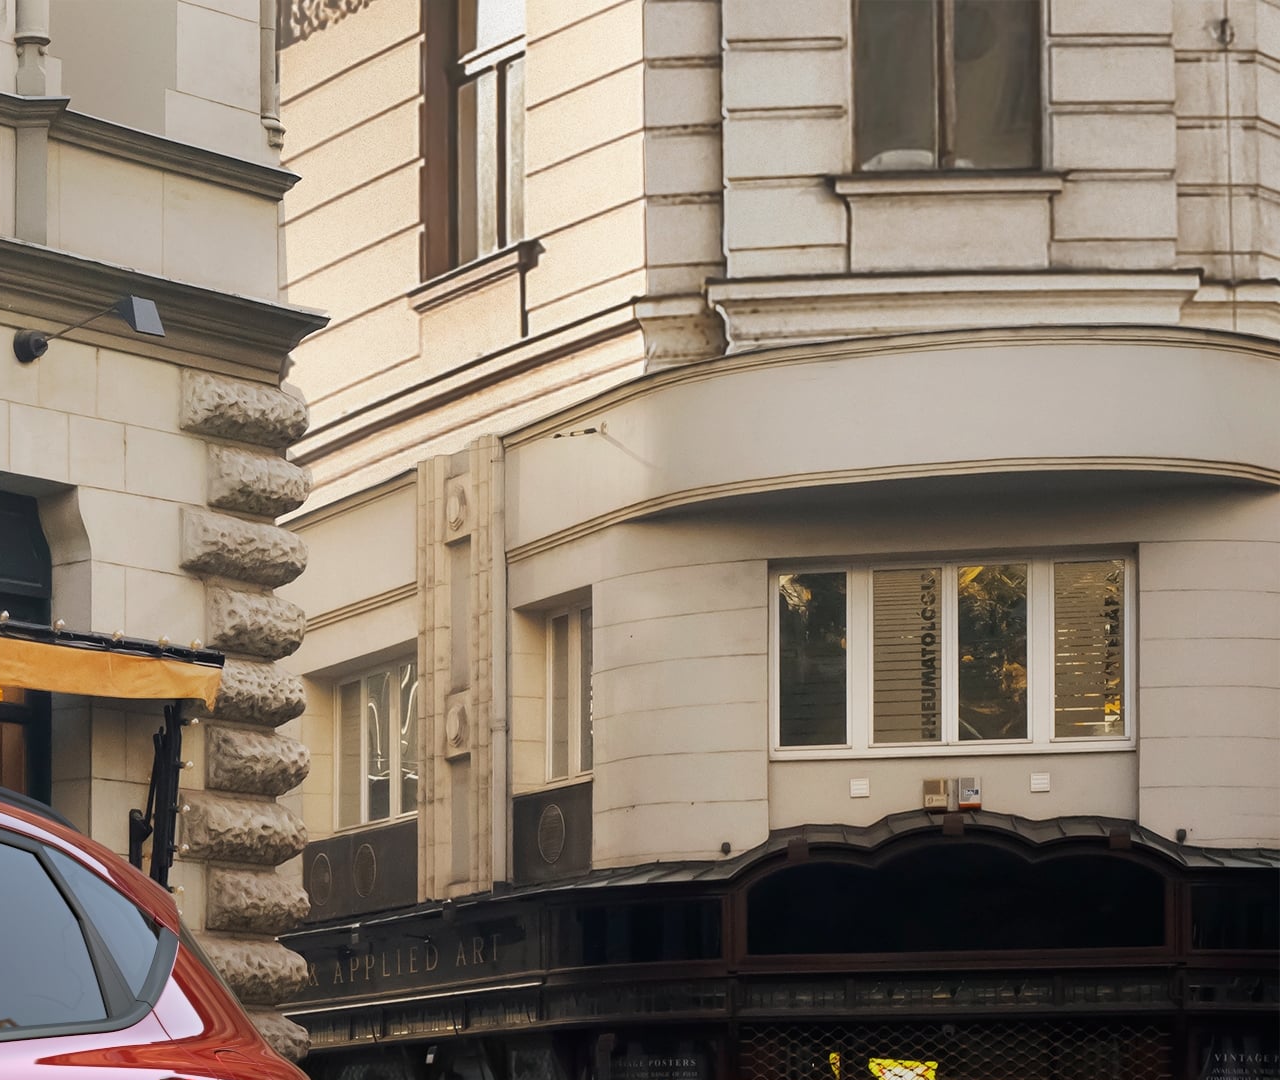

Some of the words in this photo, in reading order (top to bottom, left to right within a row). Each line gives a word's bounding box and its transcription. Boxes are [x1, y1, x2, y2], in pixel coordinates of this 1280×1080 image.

[333, 943, 439, 985] APPLIED
[455, 933, 503, 968] ART
[648, 1058, 697, 1067] POSTERS
